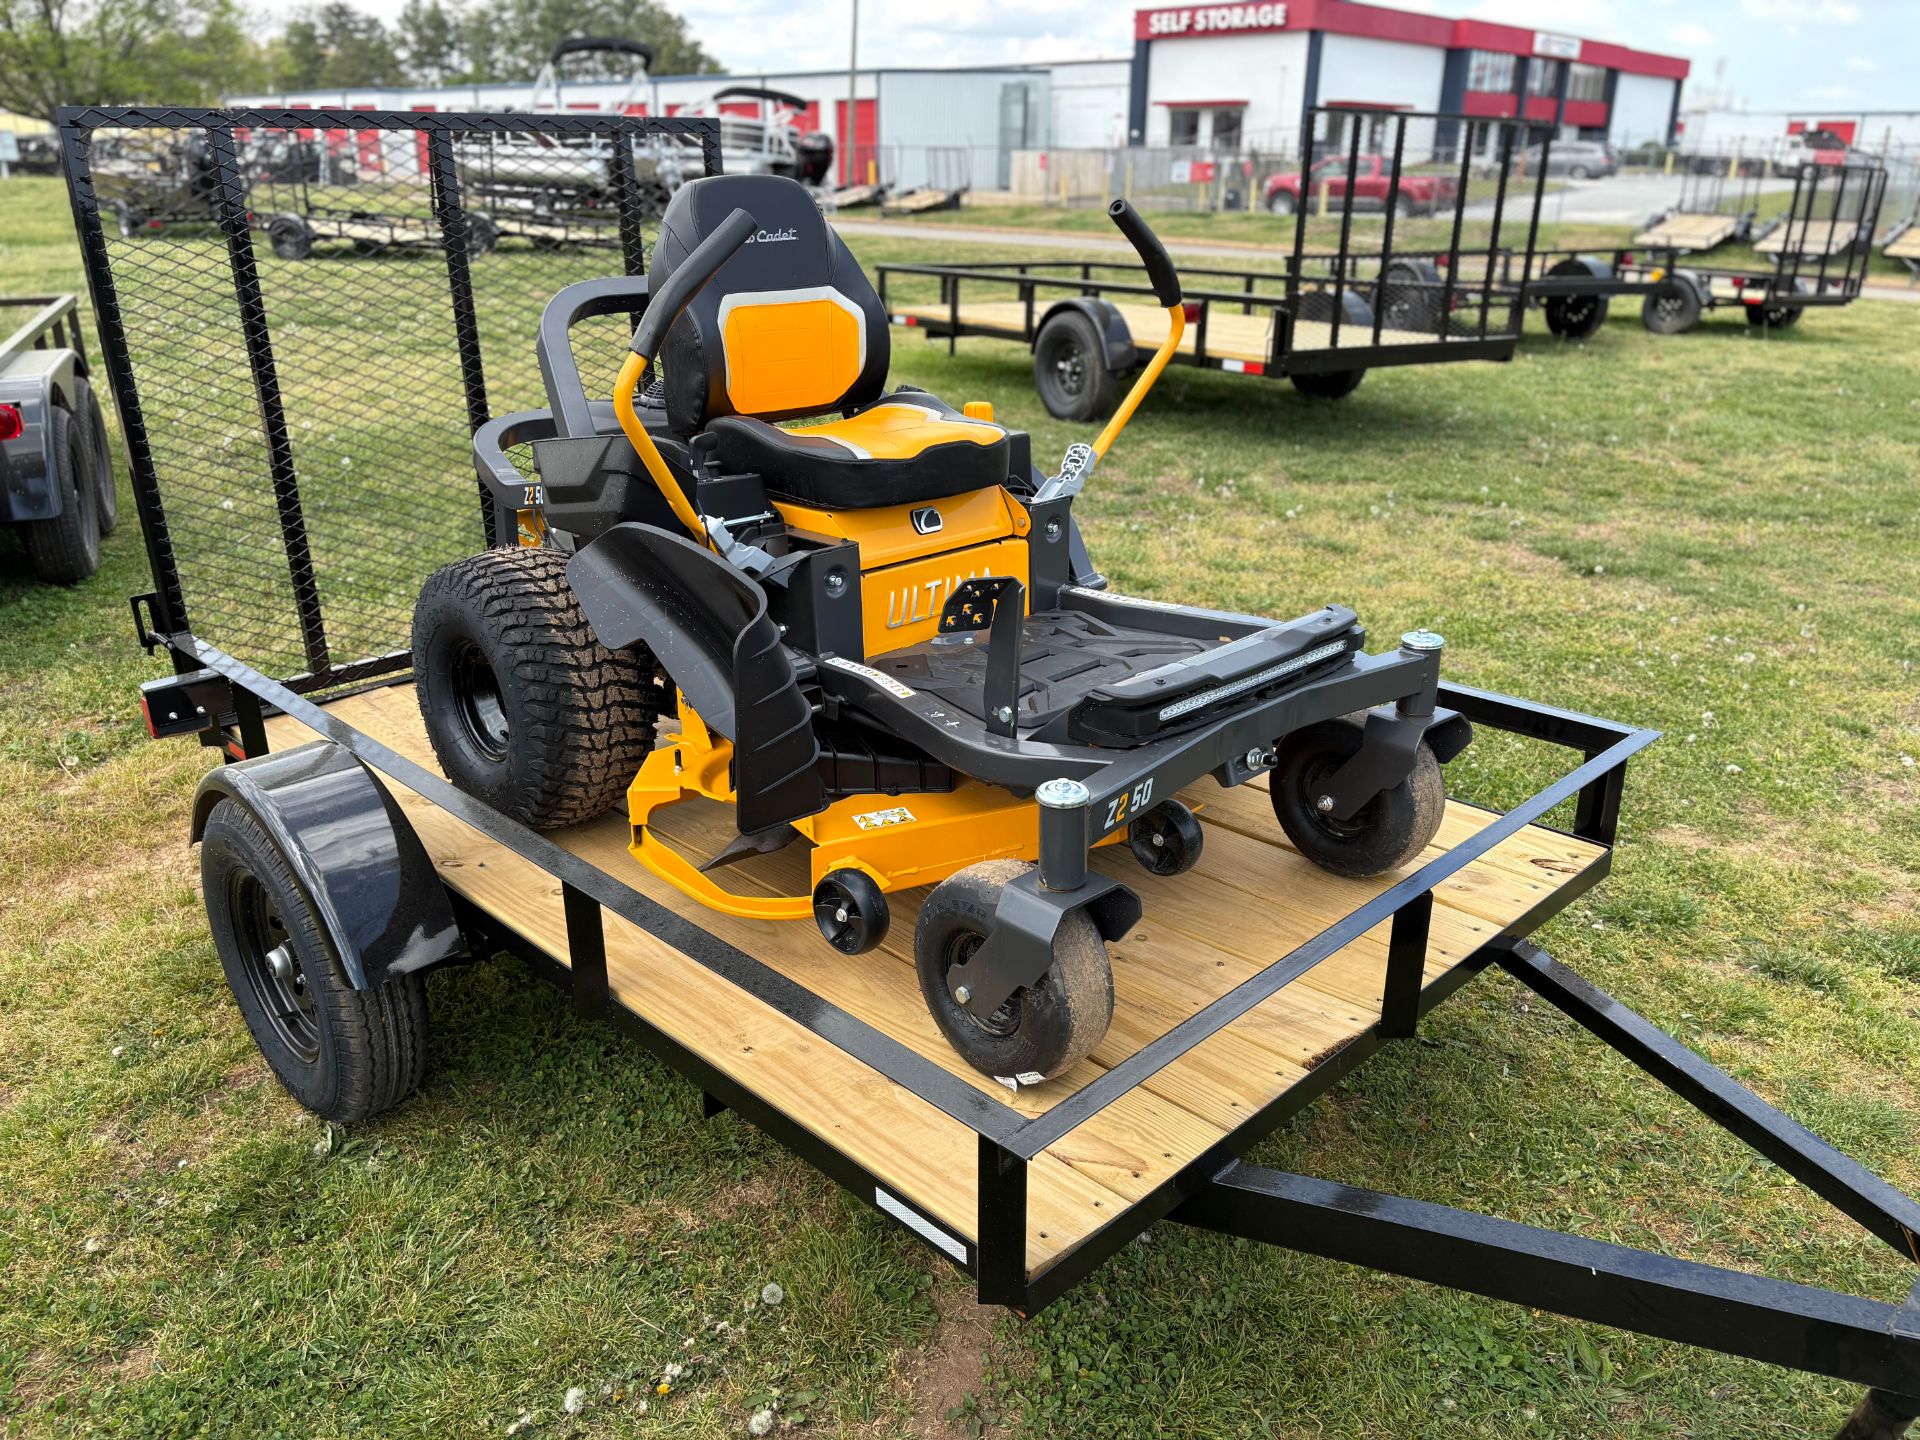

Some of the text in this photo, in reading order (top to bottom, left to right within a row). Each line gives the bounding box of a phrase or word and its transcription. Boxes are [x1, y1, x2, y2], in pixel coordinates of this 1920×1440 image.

[1149, 3, 1287, 34] SELF STORAGE
[757, 227, 797, 242] Cadet
[886, 566, 991, 629] ULTI
